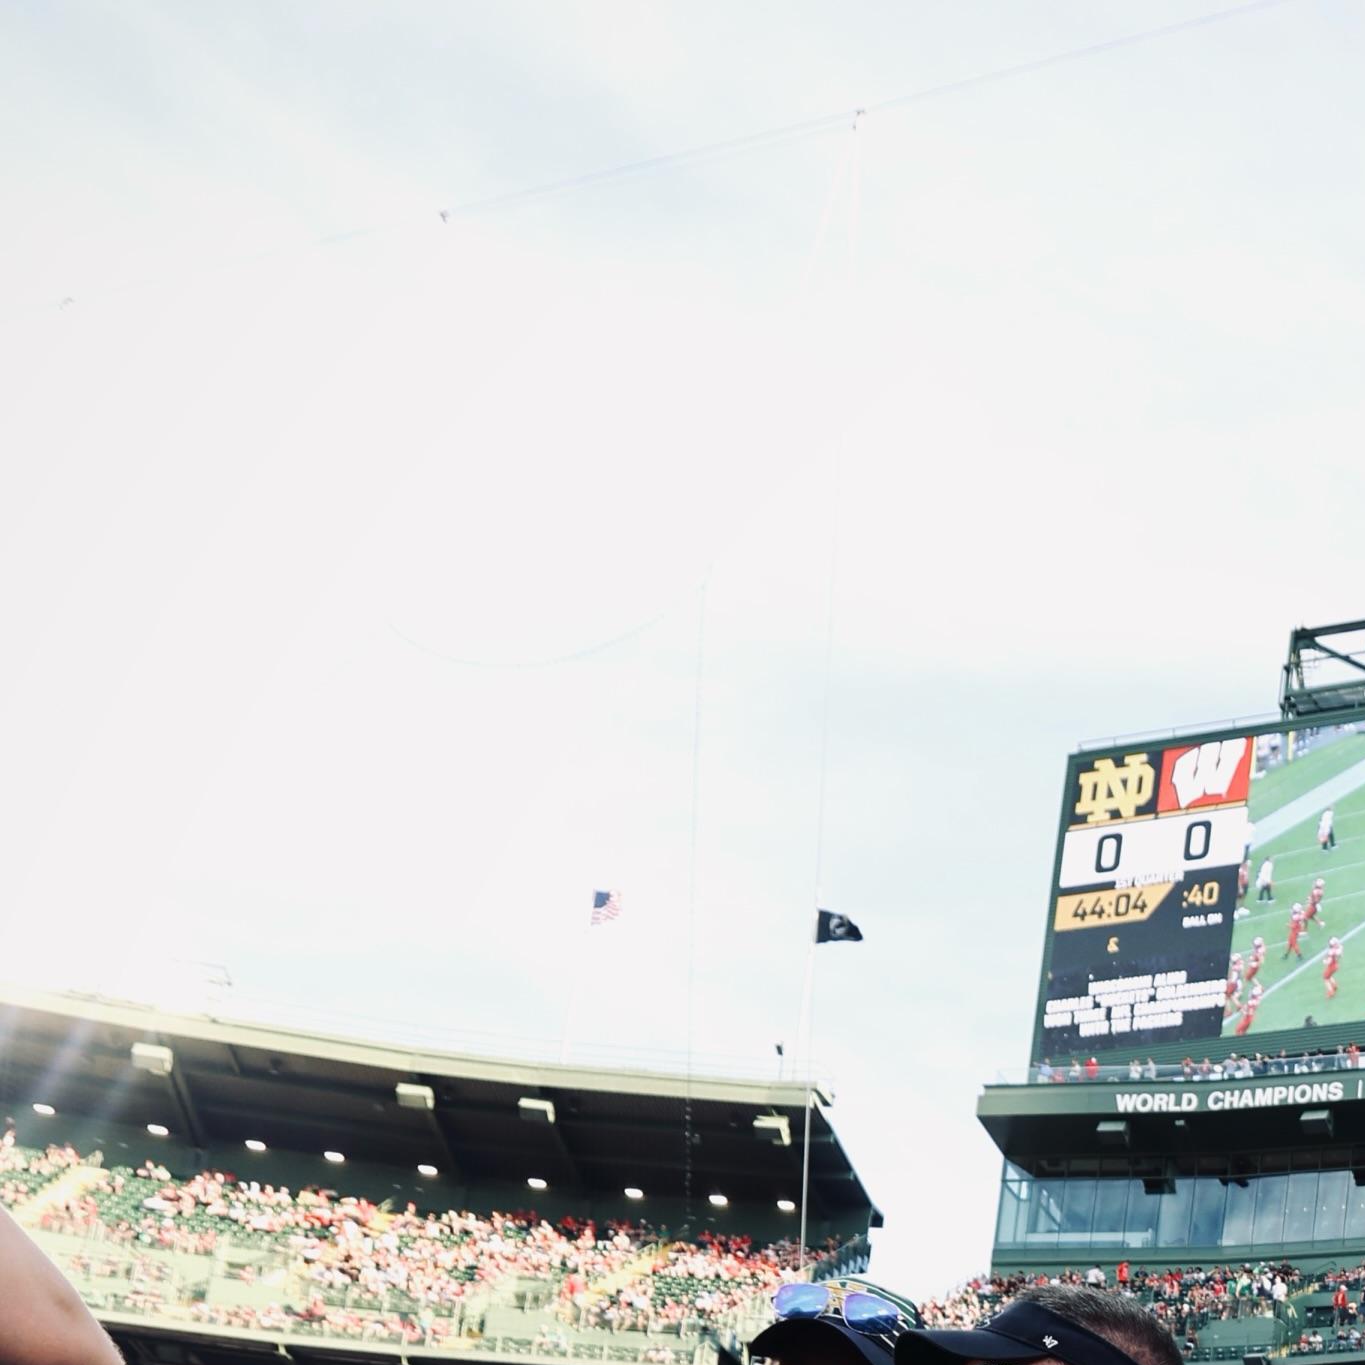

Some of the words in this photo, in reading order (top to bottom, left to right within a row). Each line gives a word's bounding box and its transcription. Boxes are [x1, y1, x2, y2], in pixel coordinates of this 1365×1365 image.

[1095, 833, 1123, 873] 0
[1184, 820, 1212, 861] 0
[1072, 890, 1148, 922] 44:04
[1116, 1093, 1198, 1113] WORLD
[1207, 1081, 1344, 1109] CHAMPIONS
